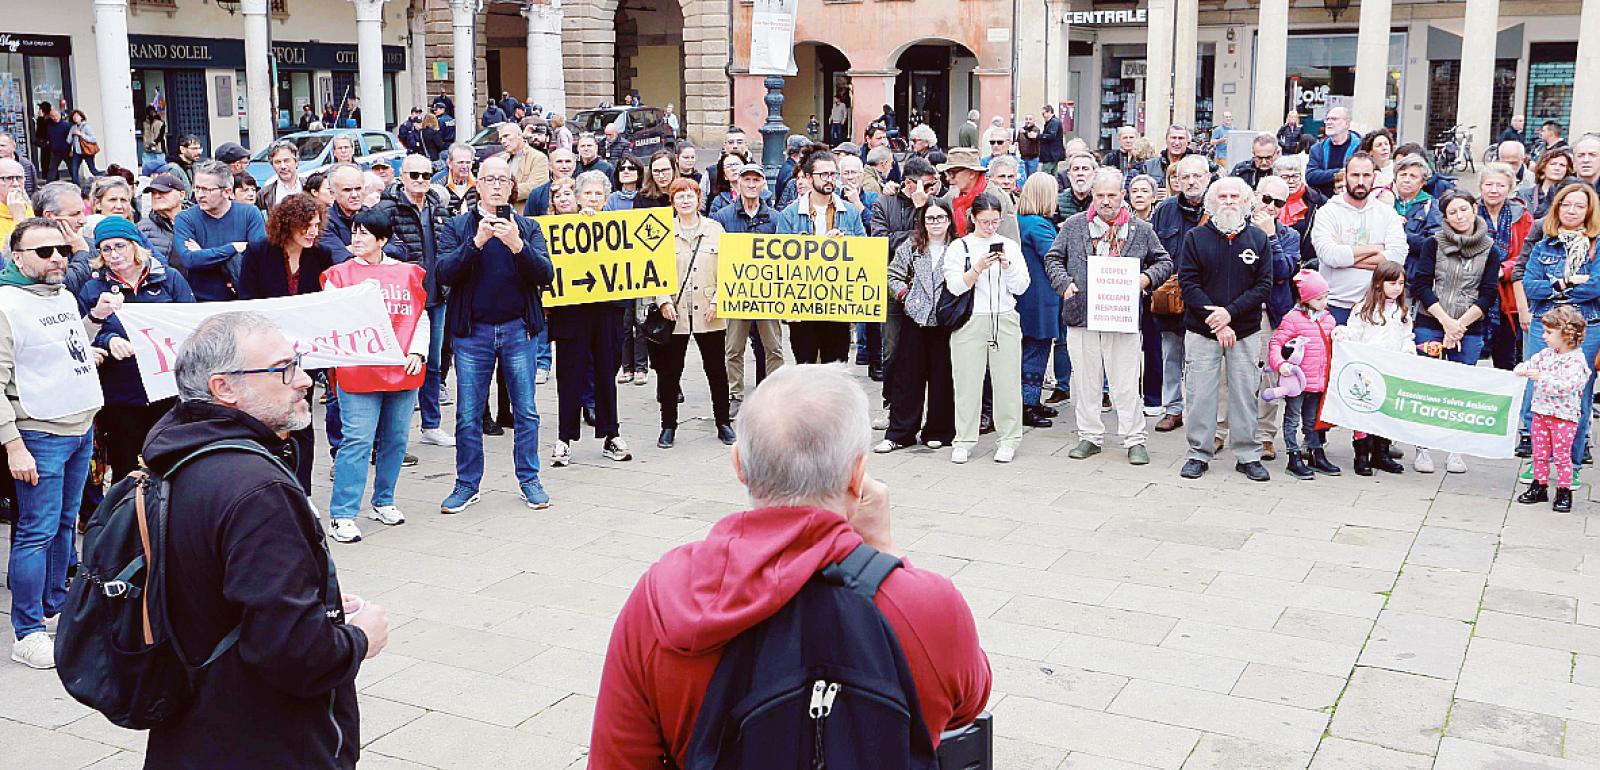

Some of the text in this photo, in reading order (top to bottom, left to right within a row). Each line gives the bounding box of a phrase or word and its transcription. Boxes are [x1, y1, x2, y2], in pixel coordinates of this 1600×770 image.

[1062, 9, 1147, 24] CENTRALE
[170, 44, 212, 60] SOLEIL
[549, 219, 634, 255] ECOPOL
[751, 237, 854, 262] ECOPOL
[600, 259, 668, 293] V.I.A.
[732, 263, 868, 283] VOGLIAMO LA
[724, 282, 880, 302] VALUTAZIONE DI
[723, 300, 881, 317] IMPATTO AMBIENTALE
[1395, 397, 1497, 427] Il Tarassaco
